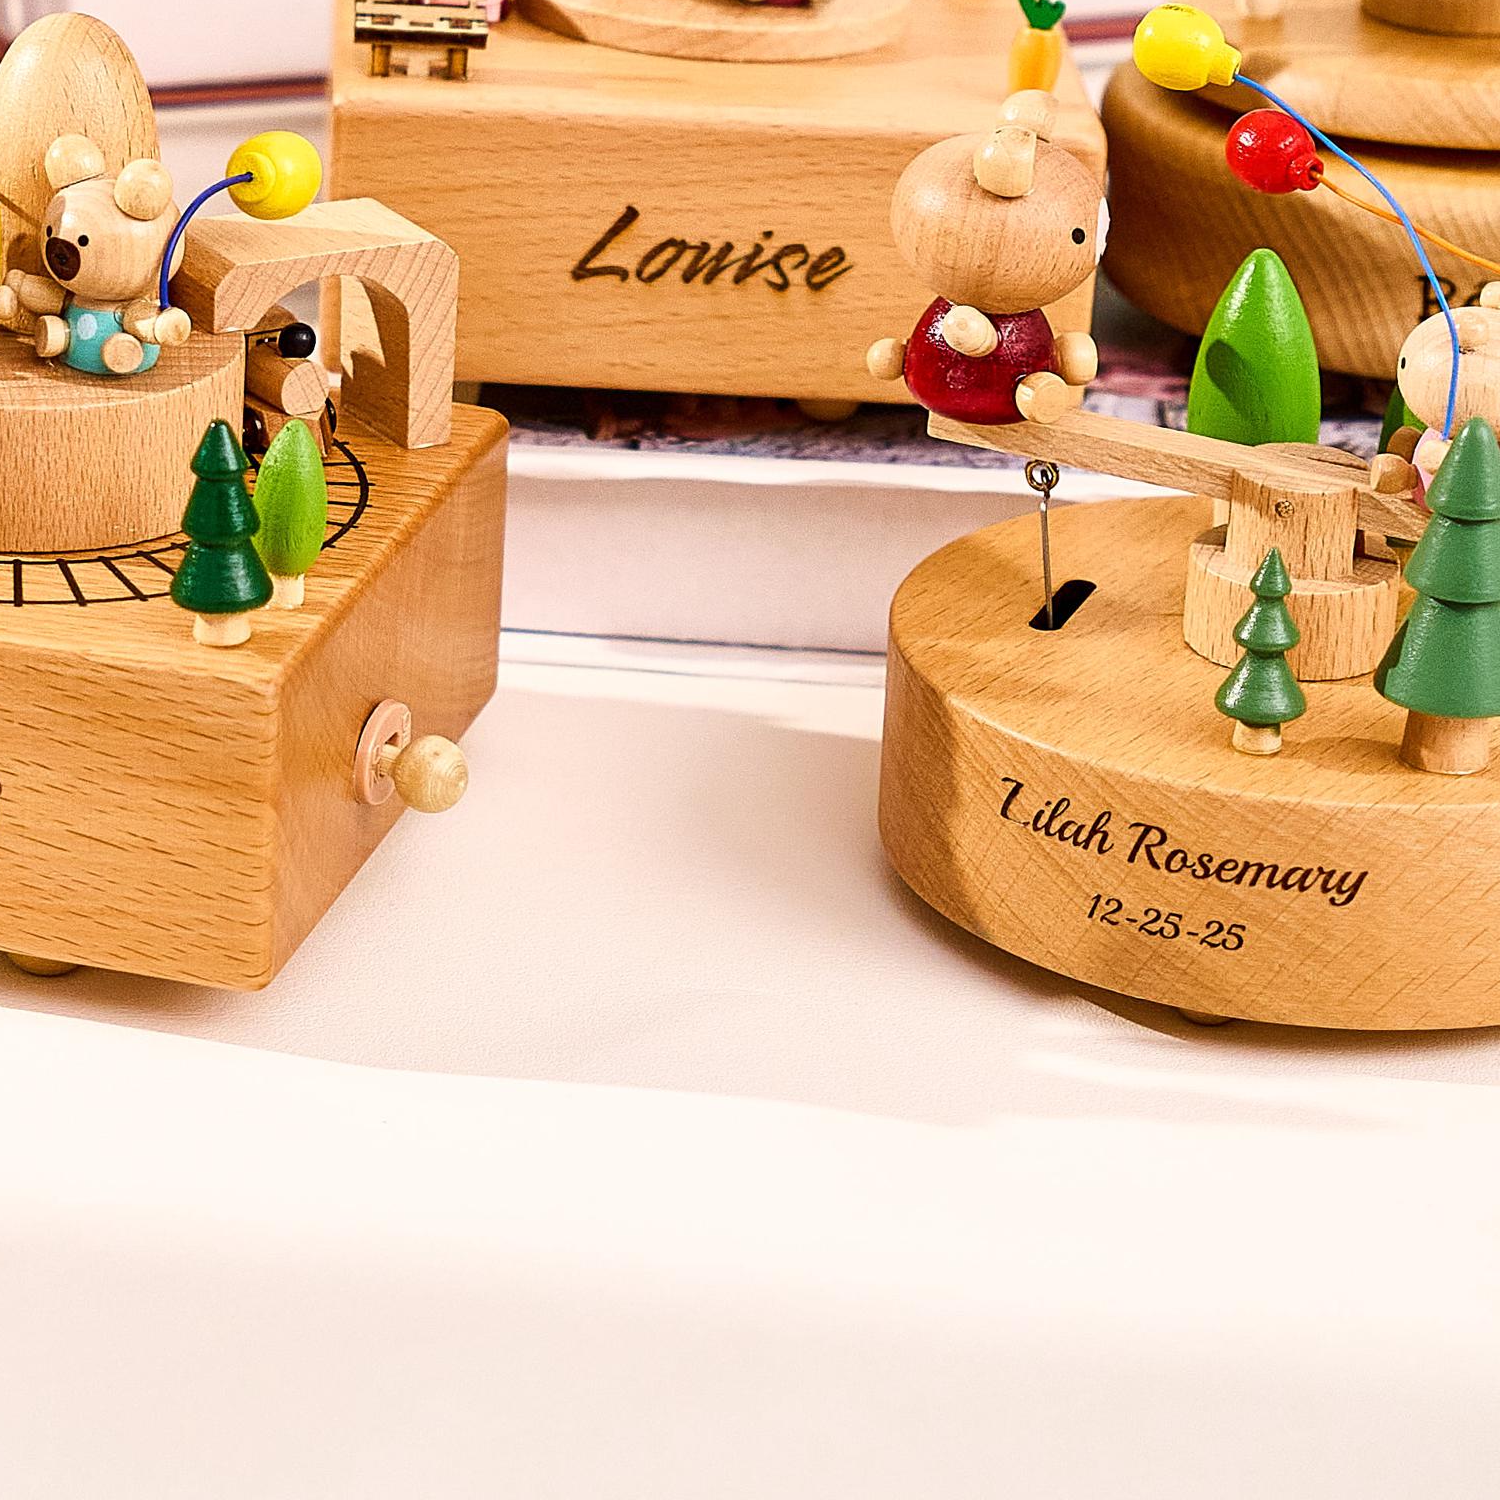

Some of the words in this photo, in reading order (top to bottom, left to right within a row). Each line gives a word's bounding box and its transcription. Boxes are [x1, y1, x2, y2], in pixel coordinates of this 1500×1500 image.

[570, 204, 854, 293] Louise
[1000, 776, 1114, 855] Lilah
[1126, 821, 1369, 907] Rosemary
[1086, 892, 1247, 951] 12-25-25
